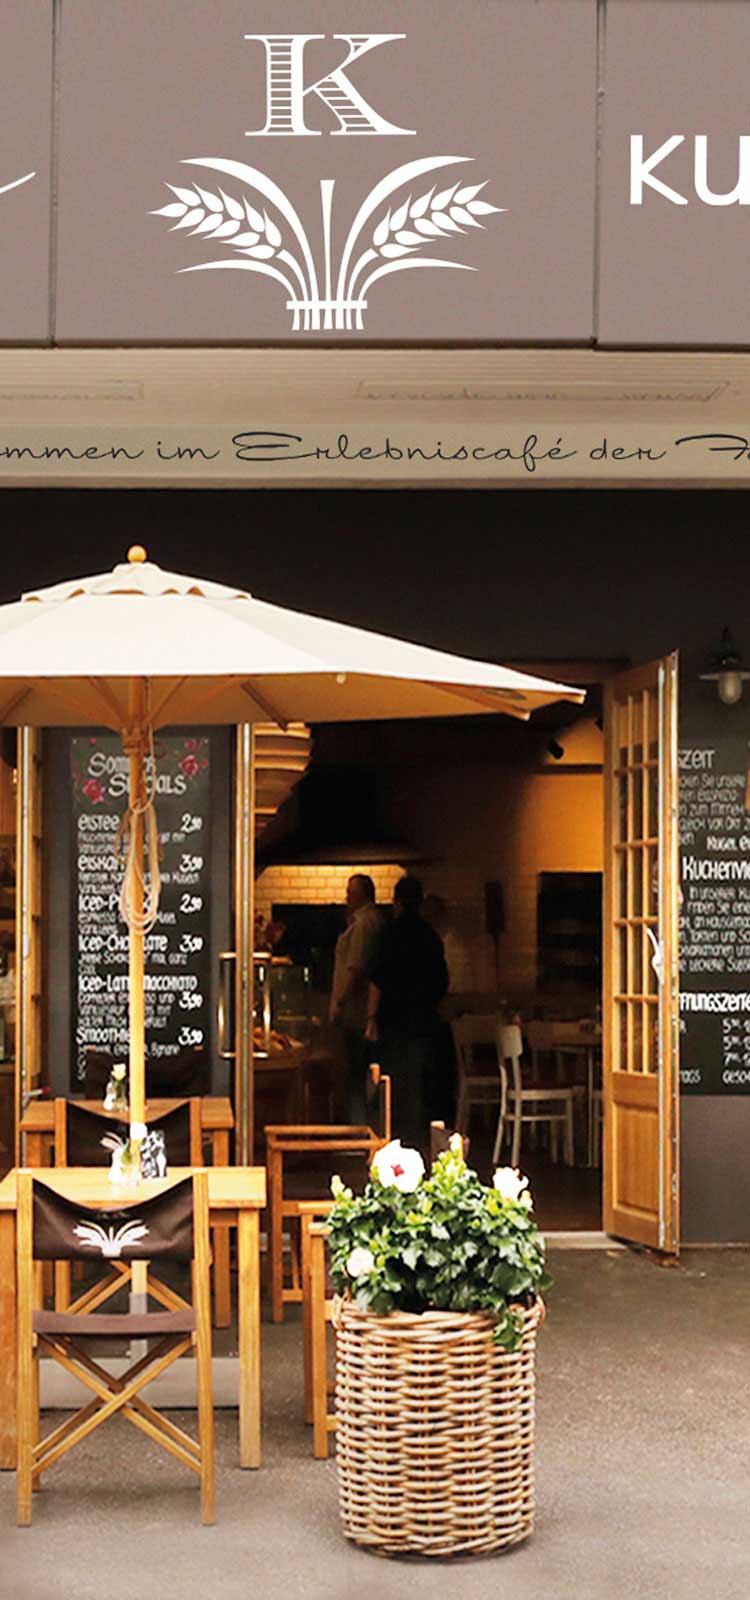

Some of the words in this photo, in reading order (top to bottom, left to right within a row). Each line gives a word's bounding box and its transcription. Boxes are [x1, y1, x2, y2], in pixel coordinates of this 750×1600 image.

[244, 34, 417, 136] K
[0, 447, 145, 460] mmen
[157, 441, 221, 460] im
[232, 431, 577, 472] Erlebniscafé
[590, 438, 667, 460] der
[674, 434, 750, 460] F
